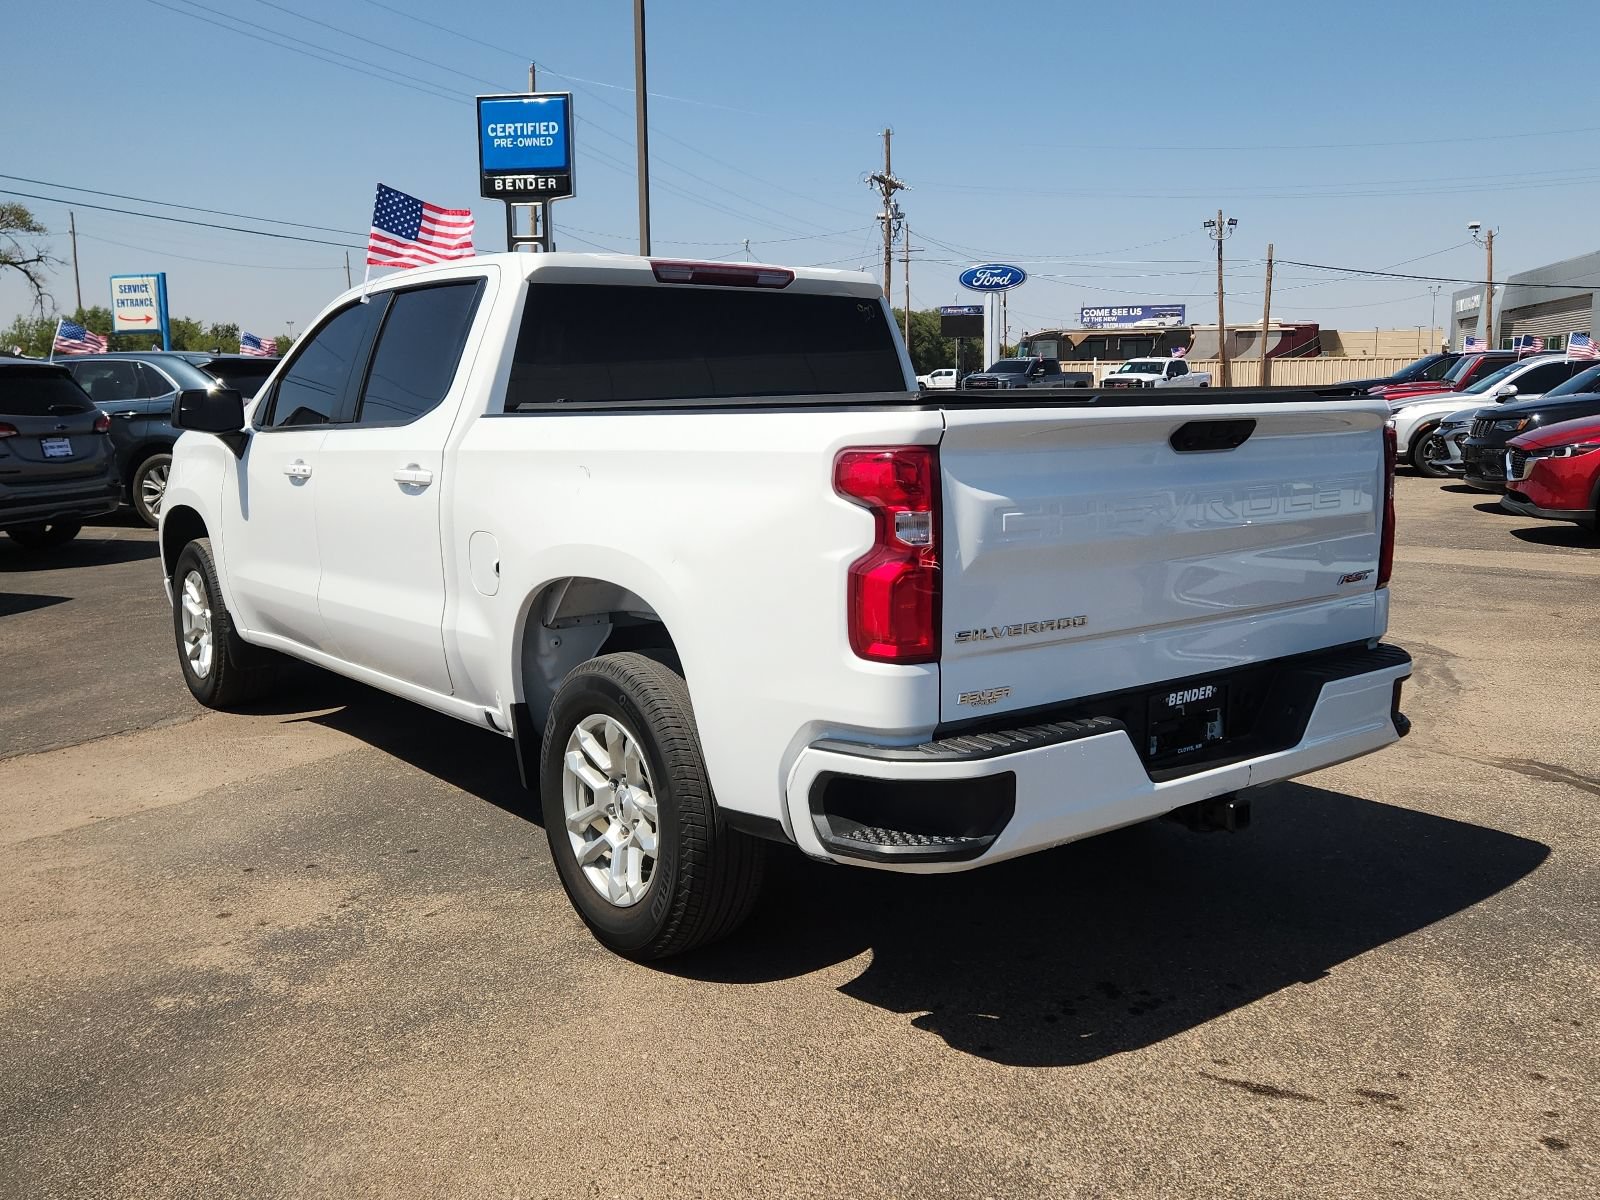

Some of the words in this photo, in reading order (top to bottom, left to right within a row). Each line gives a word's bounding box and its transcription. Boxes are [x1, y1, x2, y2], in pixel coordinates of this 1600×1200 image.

[487, 121, 559, 137] CERTIFIED
[493, 136, 554, 148] PRE-OWNED
[494, 178, 557, 191] BENDER
[972, 269, 1012, 286] Ford
[118, 283, 149, 294] SERVICE
[116, 297, 154, 308] ENTRANCE
[1082, 308, 1111, 317] COME
[1111, 308, 1129, 316] SEE
[1129, 307, 1143, 316] US
[993, 473, 1372, 543] CHEVROLET
[1337, 569, 1374, 585] RST
[954, 615, 1088, 643] SILVERADO
[957, 685, 1013, 705] BENDER
[1168, 685, 1213, 707] BENDER
[1177, 745, 1195, 754] CLOVIS,
